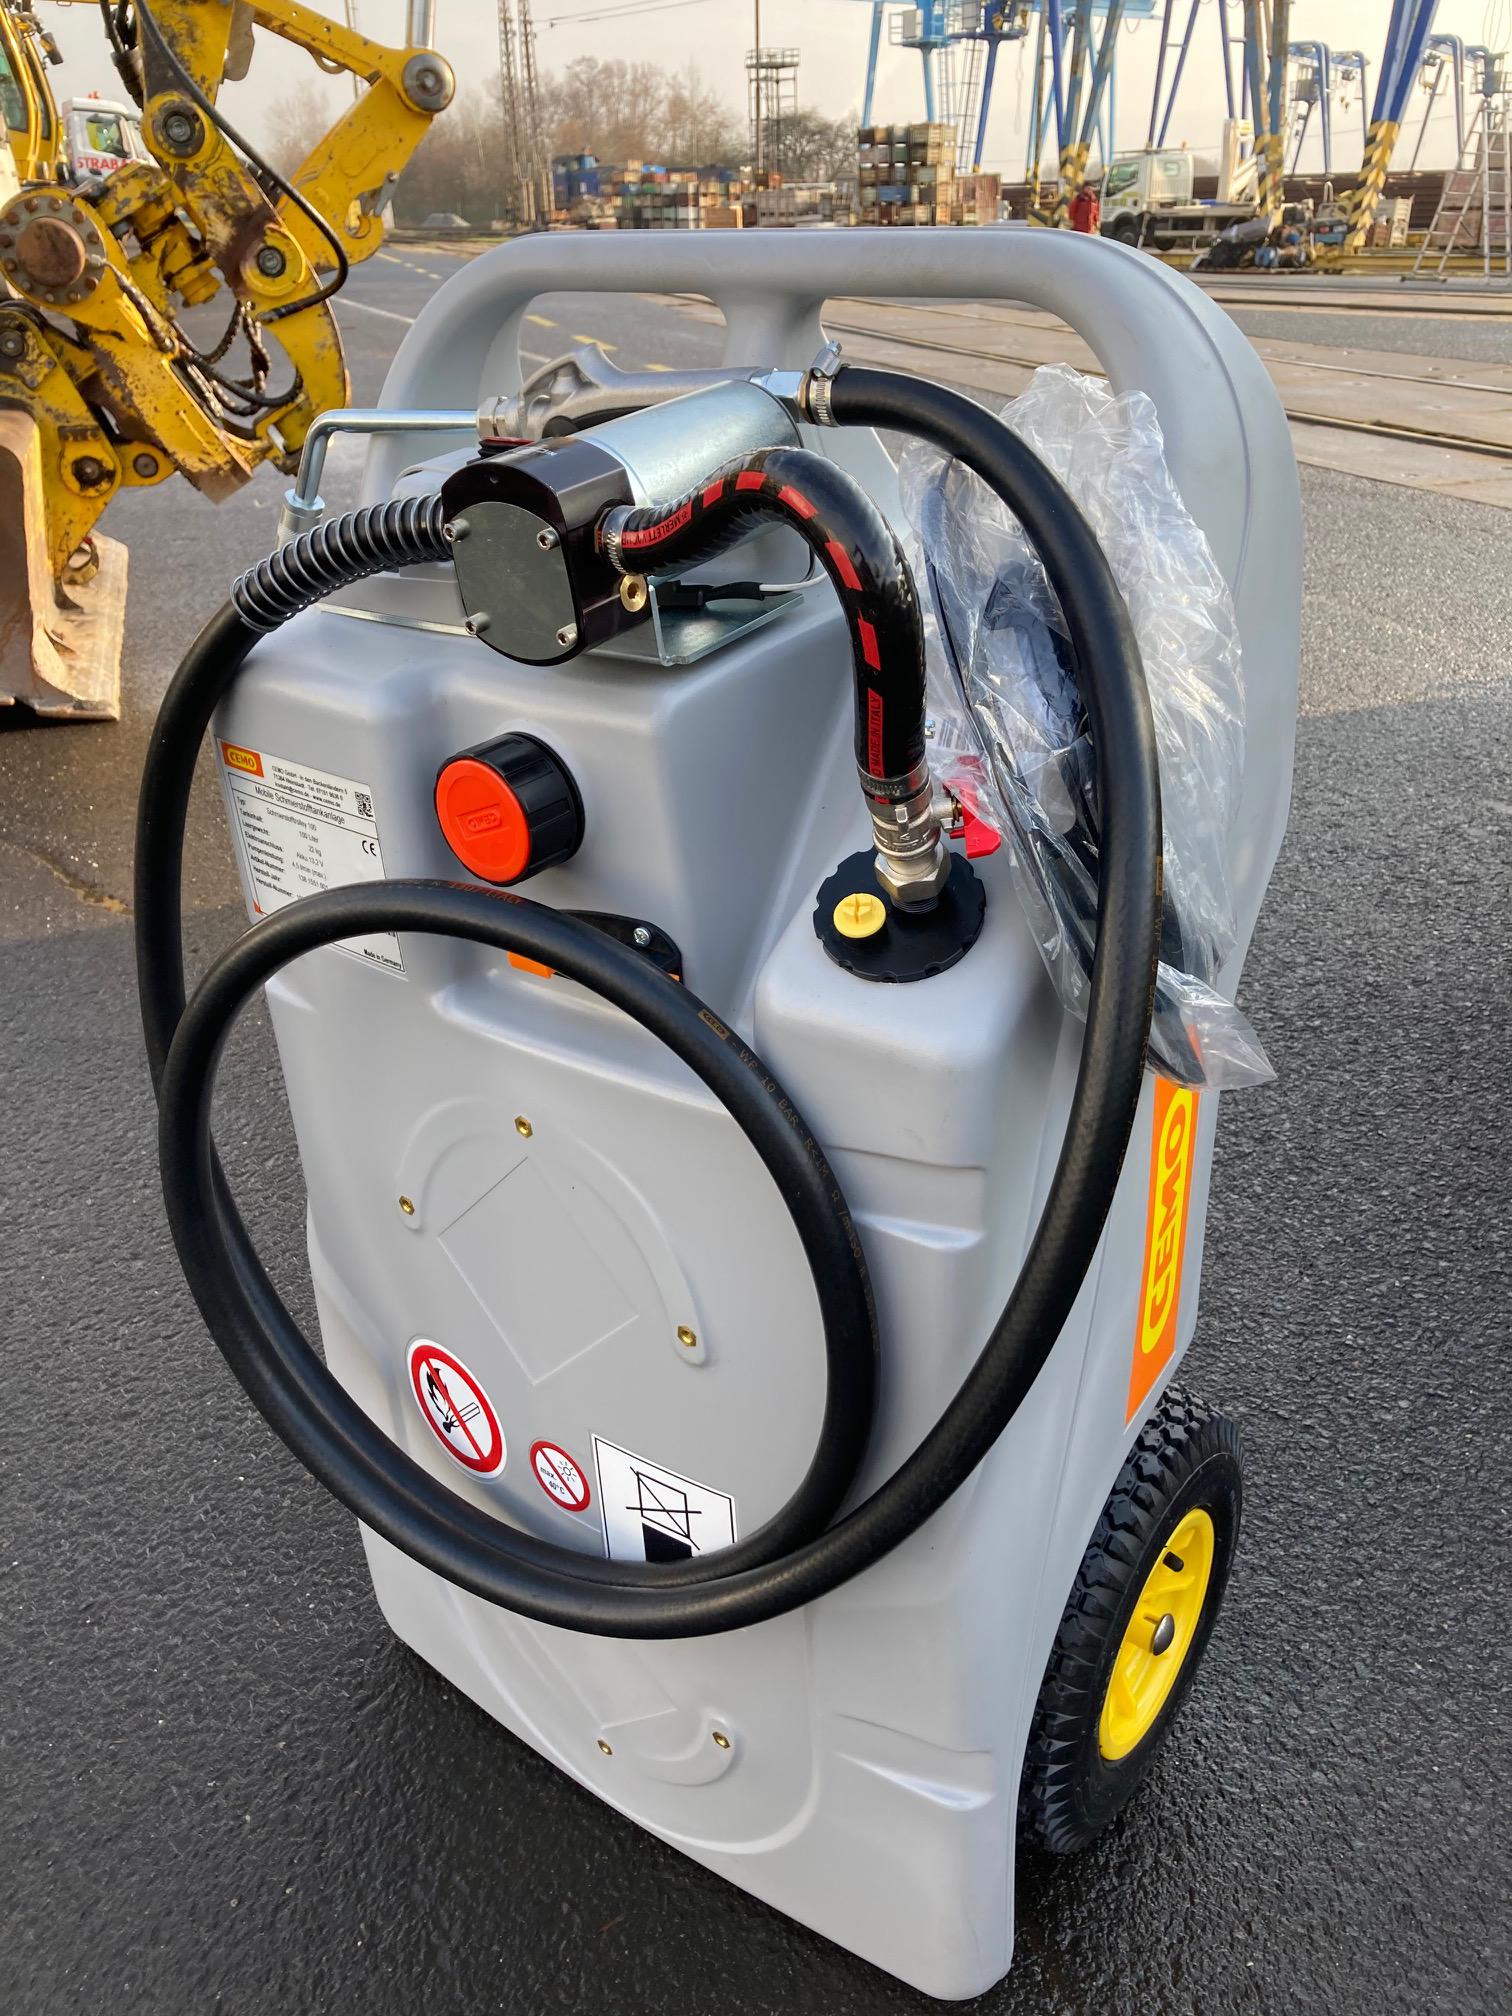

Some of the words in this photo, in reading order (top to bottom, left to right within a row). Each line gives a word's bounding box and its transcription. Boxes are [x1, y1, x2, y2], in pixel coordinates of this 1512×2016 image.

[77, 157, 137, 170] STRABA
[229, 751, 256, 769] CEMO
[255, 786, 274, 800] Mobile
[364, 948, 376, 959] Made
[1148, 1102, 1188, 1334] CEMO
